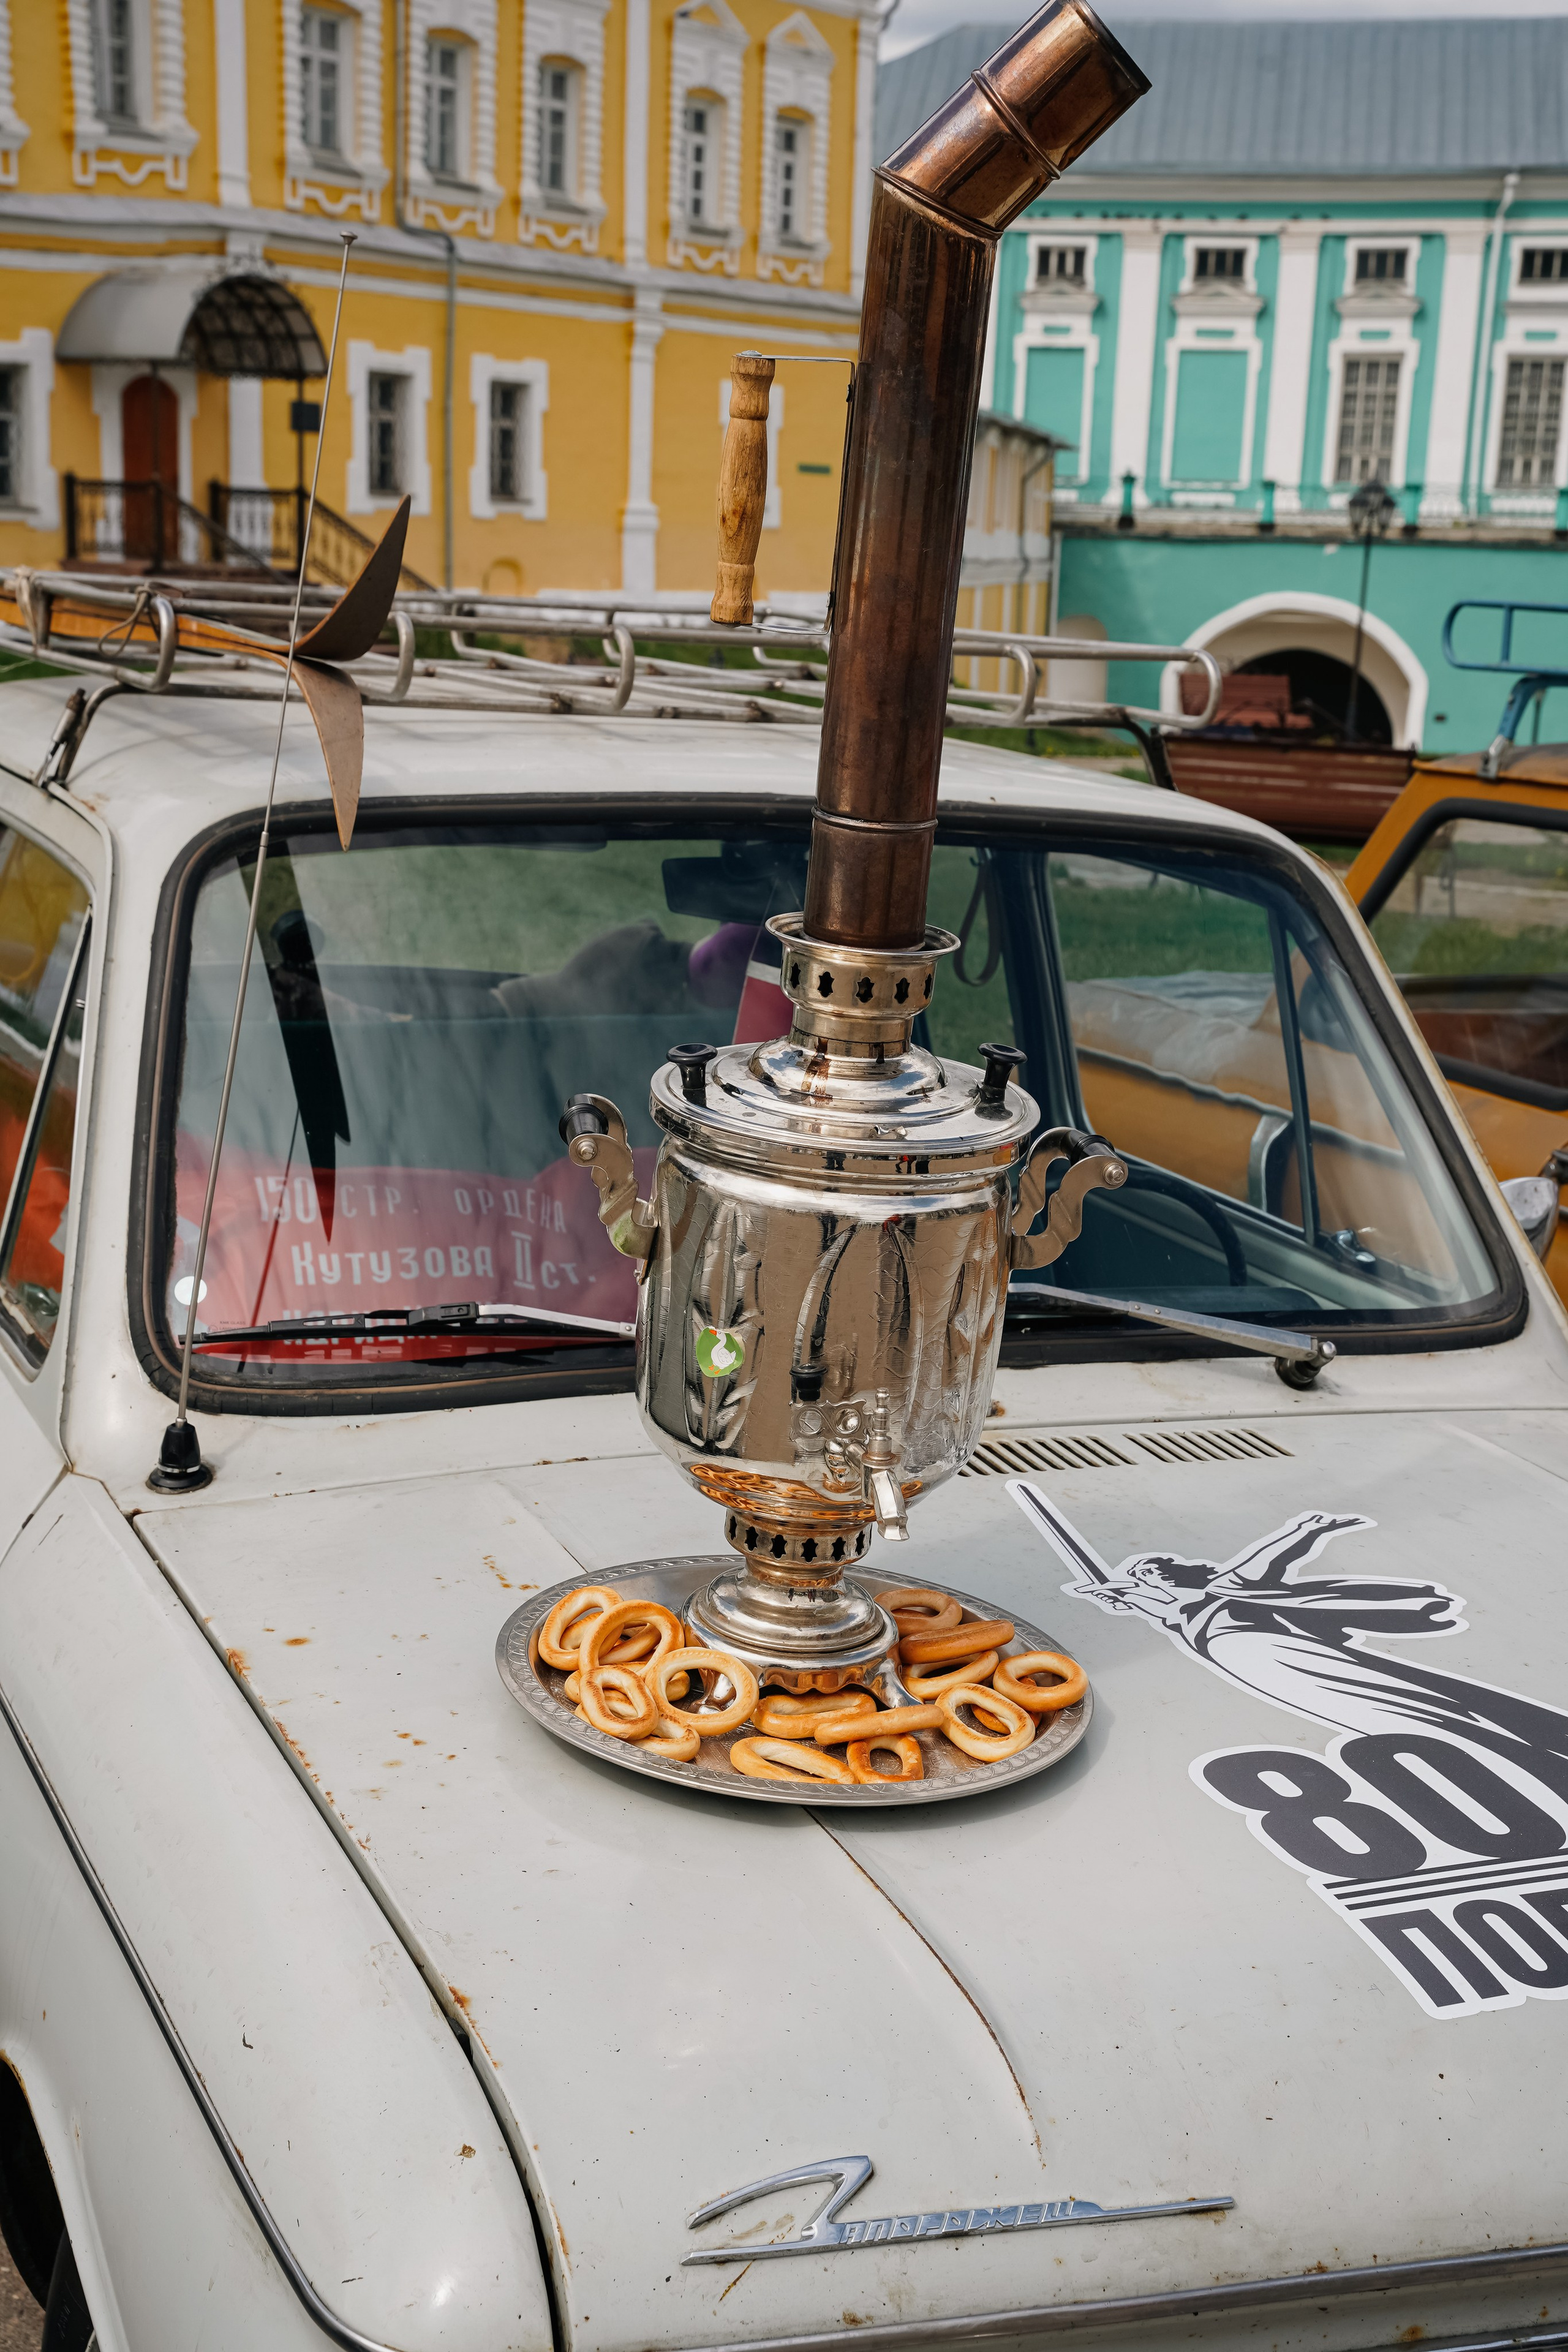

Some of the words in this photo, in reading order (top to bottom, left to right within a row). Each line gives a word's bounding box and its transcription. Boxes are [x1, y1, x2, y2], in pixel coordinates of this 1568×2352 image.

[254, 1176, 318, 1224] 150
[454, 1188, 567, 1233] ОРДЕНА
[1203, 1733, 1567, 1879] 80
[1359, 1888, 1568, 2008] ПО
